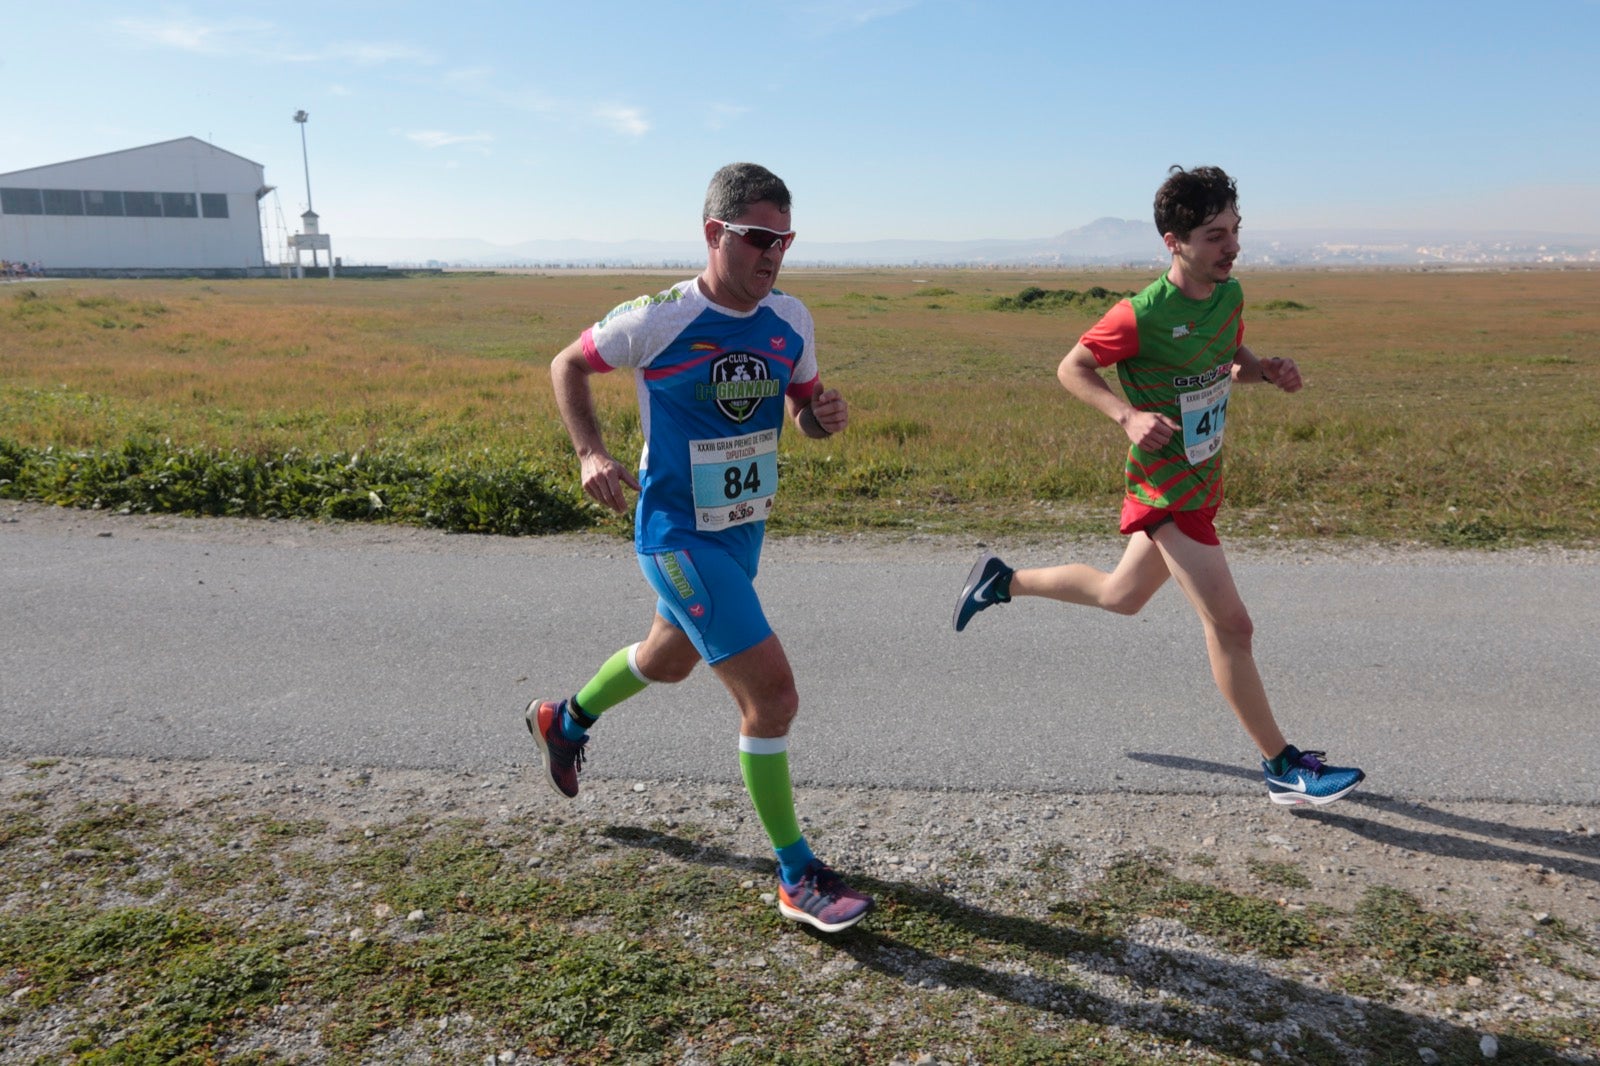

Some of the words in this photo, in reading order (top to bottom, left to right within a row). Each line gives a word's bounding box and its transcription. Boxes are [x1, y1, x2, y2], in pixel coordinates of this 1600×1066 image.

[728, 354, 749, 363] CLUB
[716, 441, 733, 450] GRAN
[724, 461, 761, 499] 84
